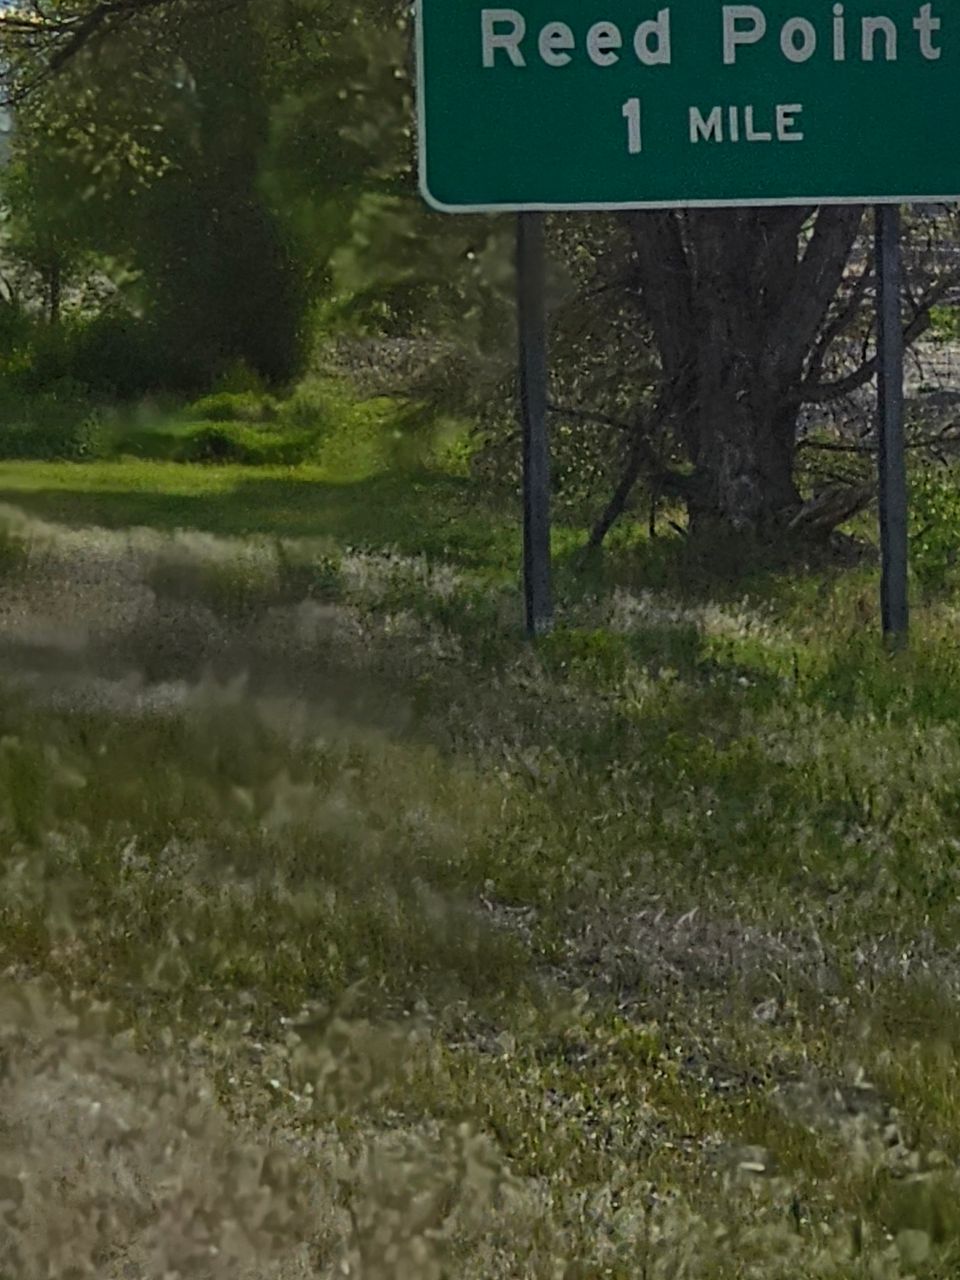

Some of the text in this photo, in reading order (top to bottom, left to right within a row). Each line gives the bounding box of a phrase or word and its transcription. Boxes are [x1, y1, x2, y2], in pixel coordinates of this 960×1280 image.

[480, 2, 941, 68] Reed Point
[621, 97, 804, 154] 1 MILE
